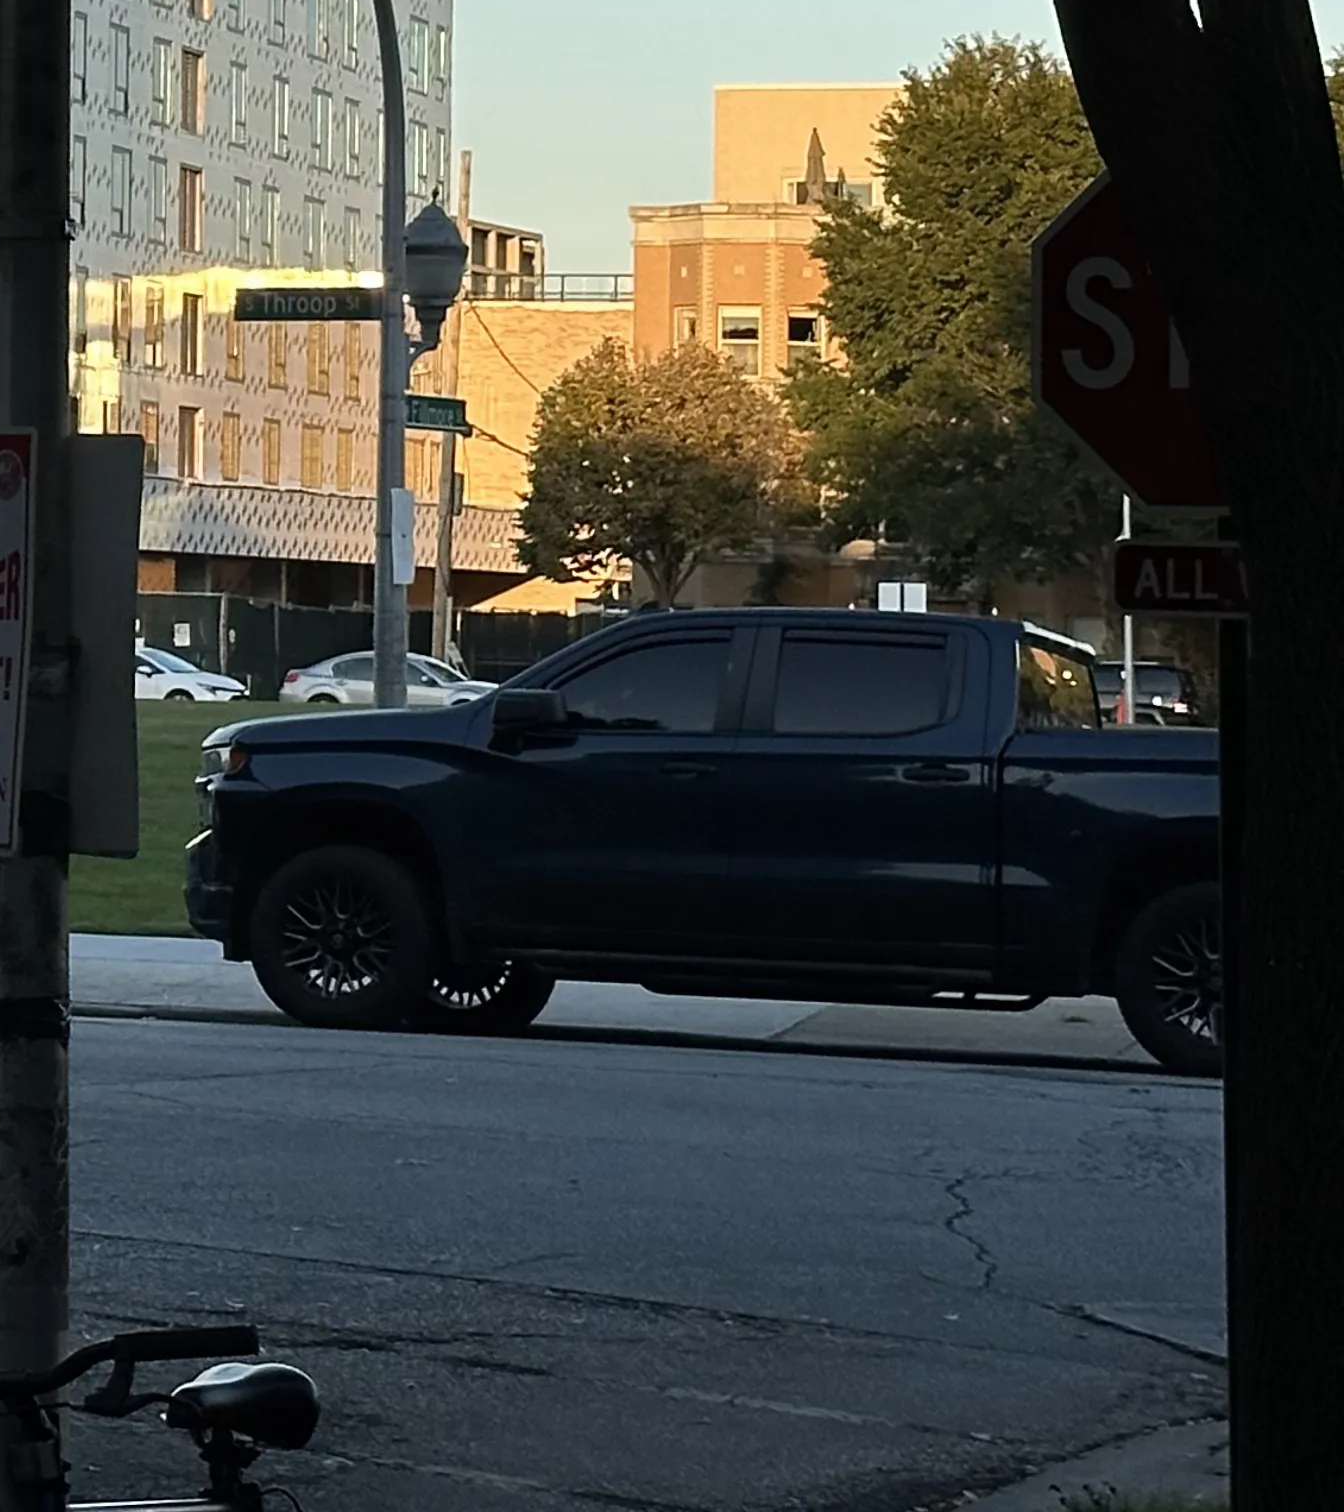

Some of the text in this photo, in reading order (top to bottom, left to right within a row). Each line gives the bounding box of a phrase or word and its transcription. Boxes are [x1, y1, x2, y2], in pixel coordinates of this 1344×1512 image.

[244, 296, 255, 312] S
[261, 292, 337, 317] Throop
[1133, 557, 1219, 601] ALL
